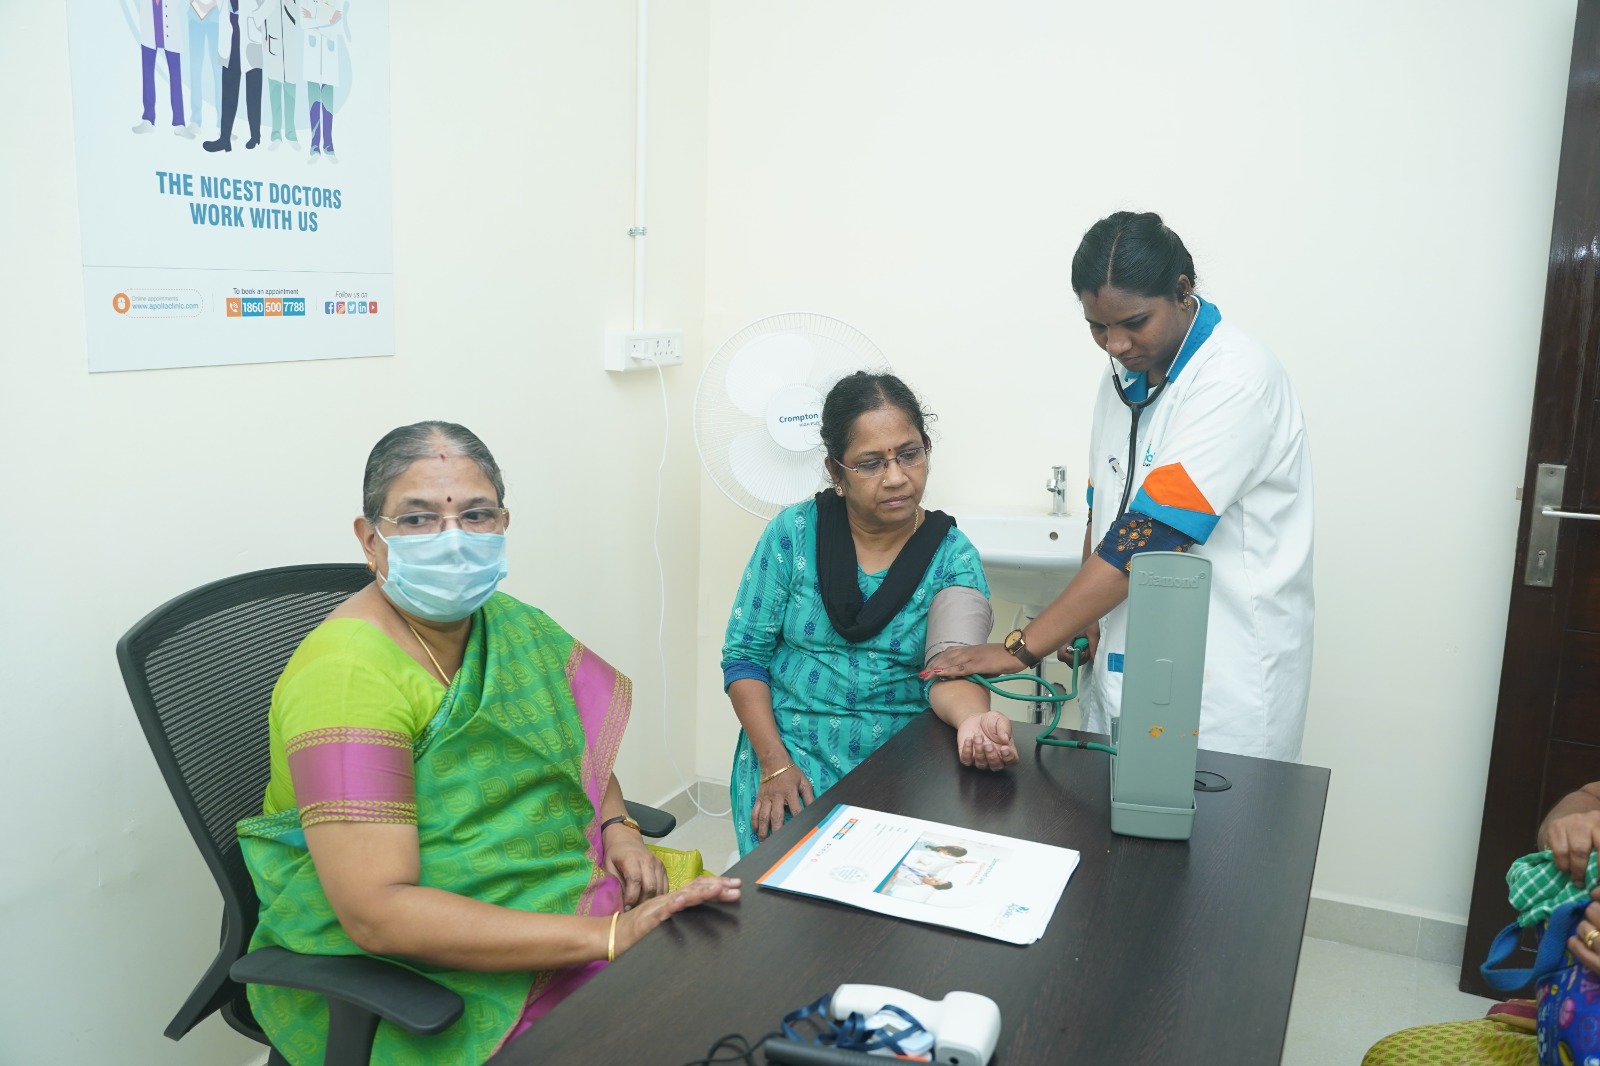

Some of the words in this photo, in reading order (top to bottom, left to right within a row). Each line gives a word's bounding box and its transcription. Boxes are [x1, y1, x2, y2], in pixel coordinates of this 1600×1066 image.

[155, 171, 194, 196] THE
[200, 176, 263, 202] NICEST
[269, 183, 342, 209] DOCTORS
[190, 203, 245, 227] WORK
[250, 208, 293, 230] WITH
[298, 211, 318, 232] US
[233, 287, 240, 295] To
[265, 288, 299, 296] appointment
[335, 291, 352, 299] Follow
[132, 303, 199, 311] www.apolloclinic.com
[242, 302, 263, 313] 1860
[265, 302, 282, 313] 500
[283, 302, 305, 312] 7788
[779, 413, 819, 423] Crompton
